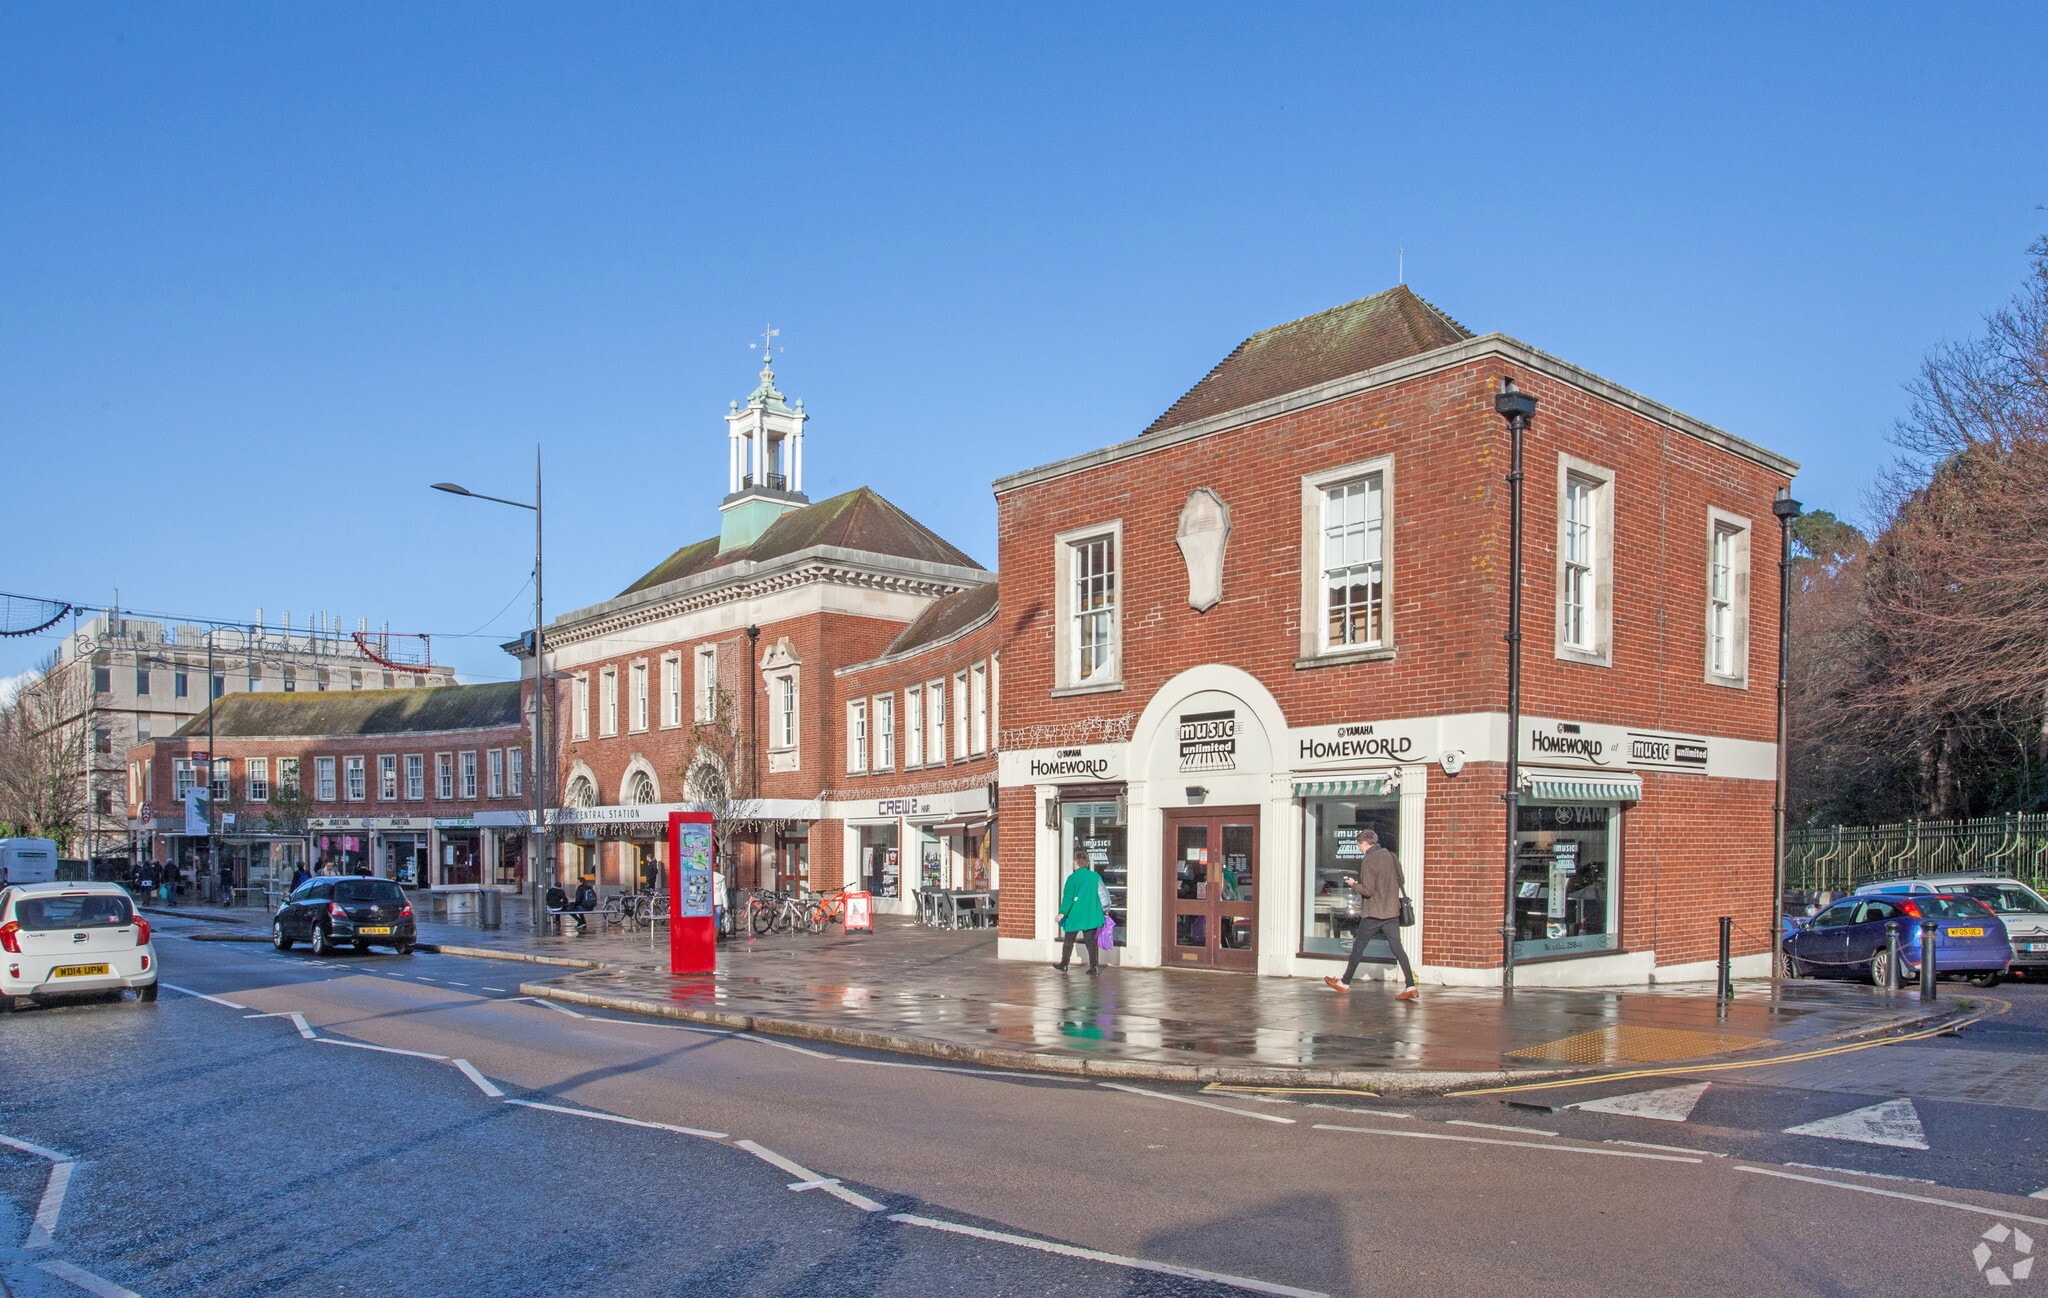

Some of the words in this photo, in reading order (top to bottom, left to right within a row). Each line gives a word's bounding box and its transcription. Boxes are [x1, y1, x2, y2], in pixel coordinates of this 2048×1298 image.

[1180, 720, 1235, 741] music
[1346, 725, 1374, 736] YAMAHA
[1183, 742, 1232, 754] unlimited
[1633, 740, 1669, 760] music
[1676, 747, 1707, 760] unlimited
[575, 810, 606, 820] CENTRAL
[609, 808, 640, 819] STATION
[1555, 844, 1576, 852] music
[1951, 928, 1968, 936] WF05
[60, 967, 82, 977] WD14
